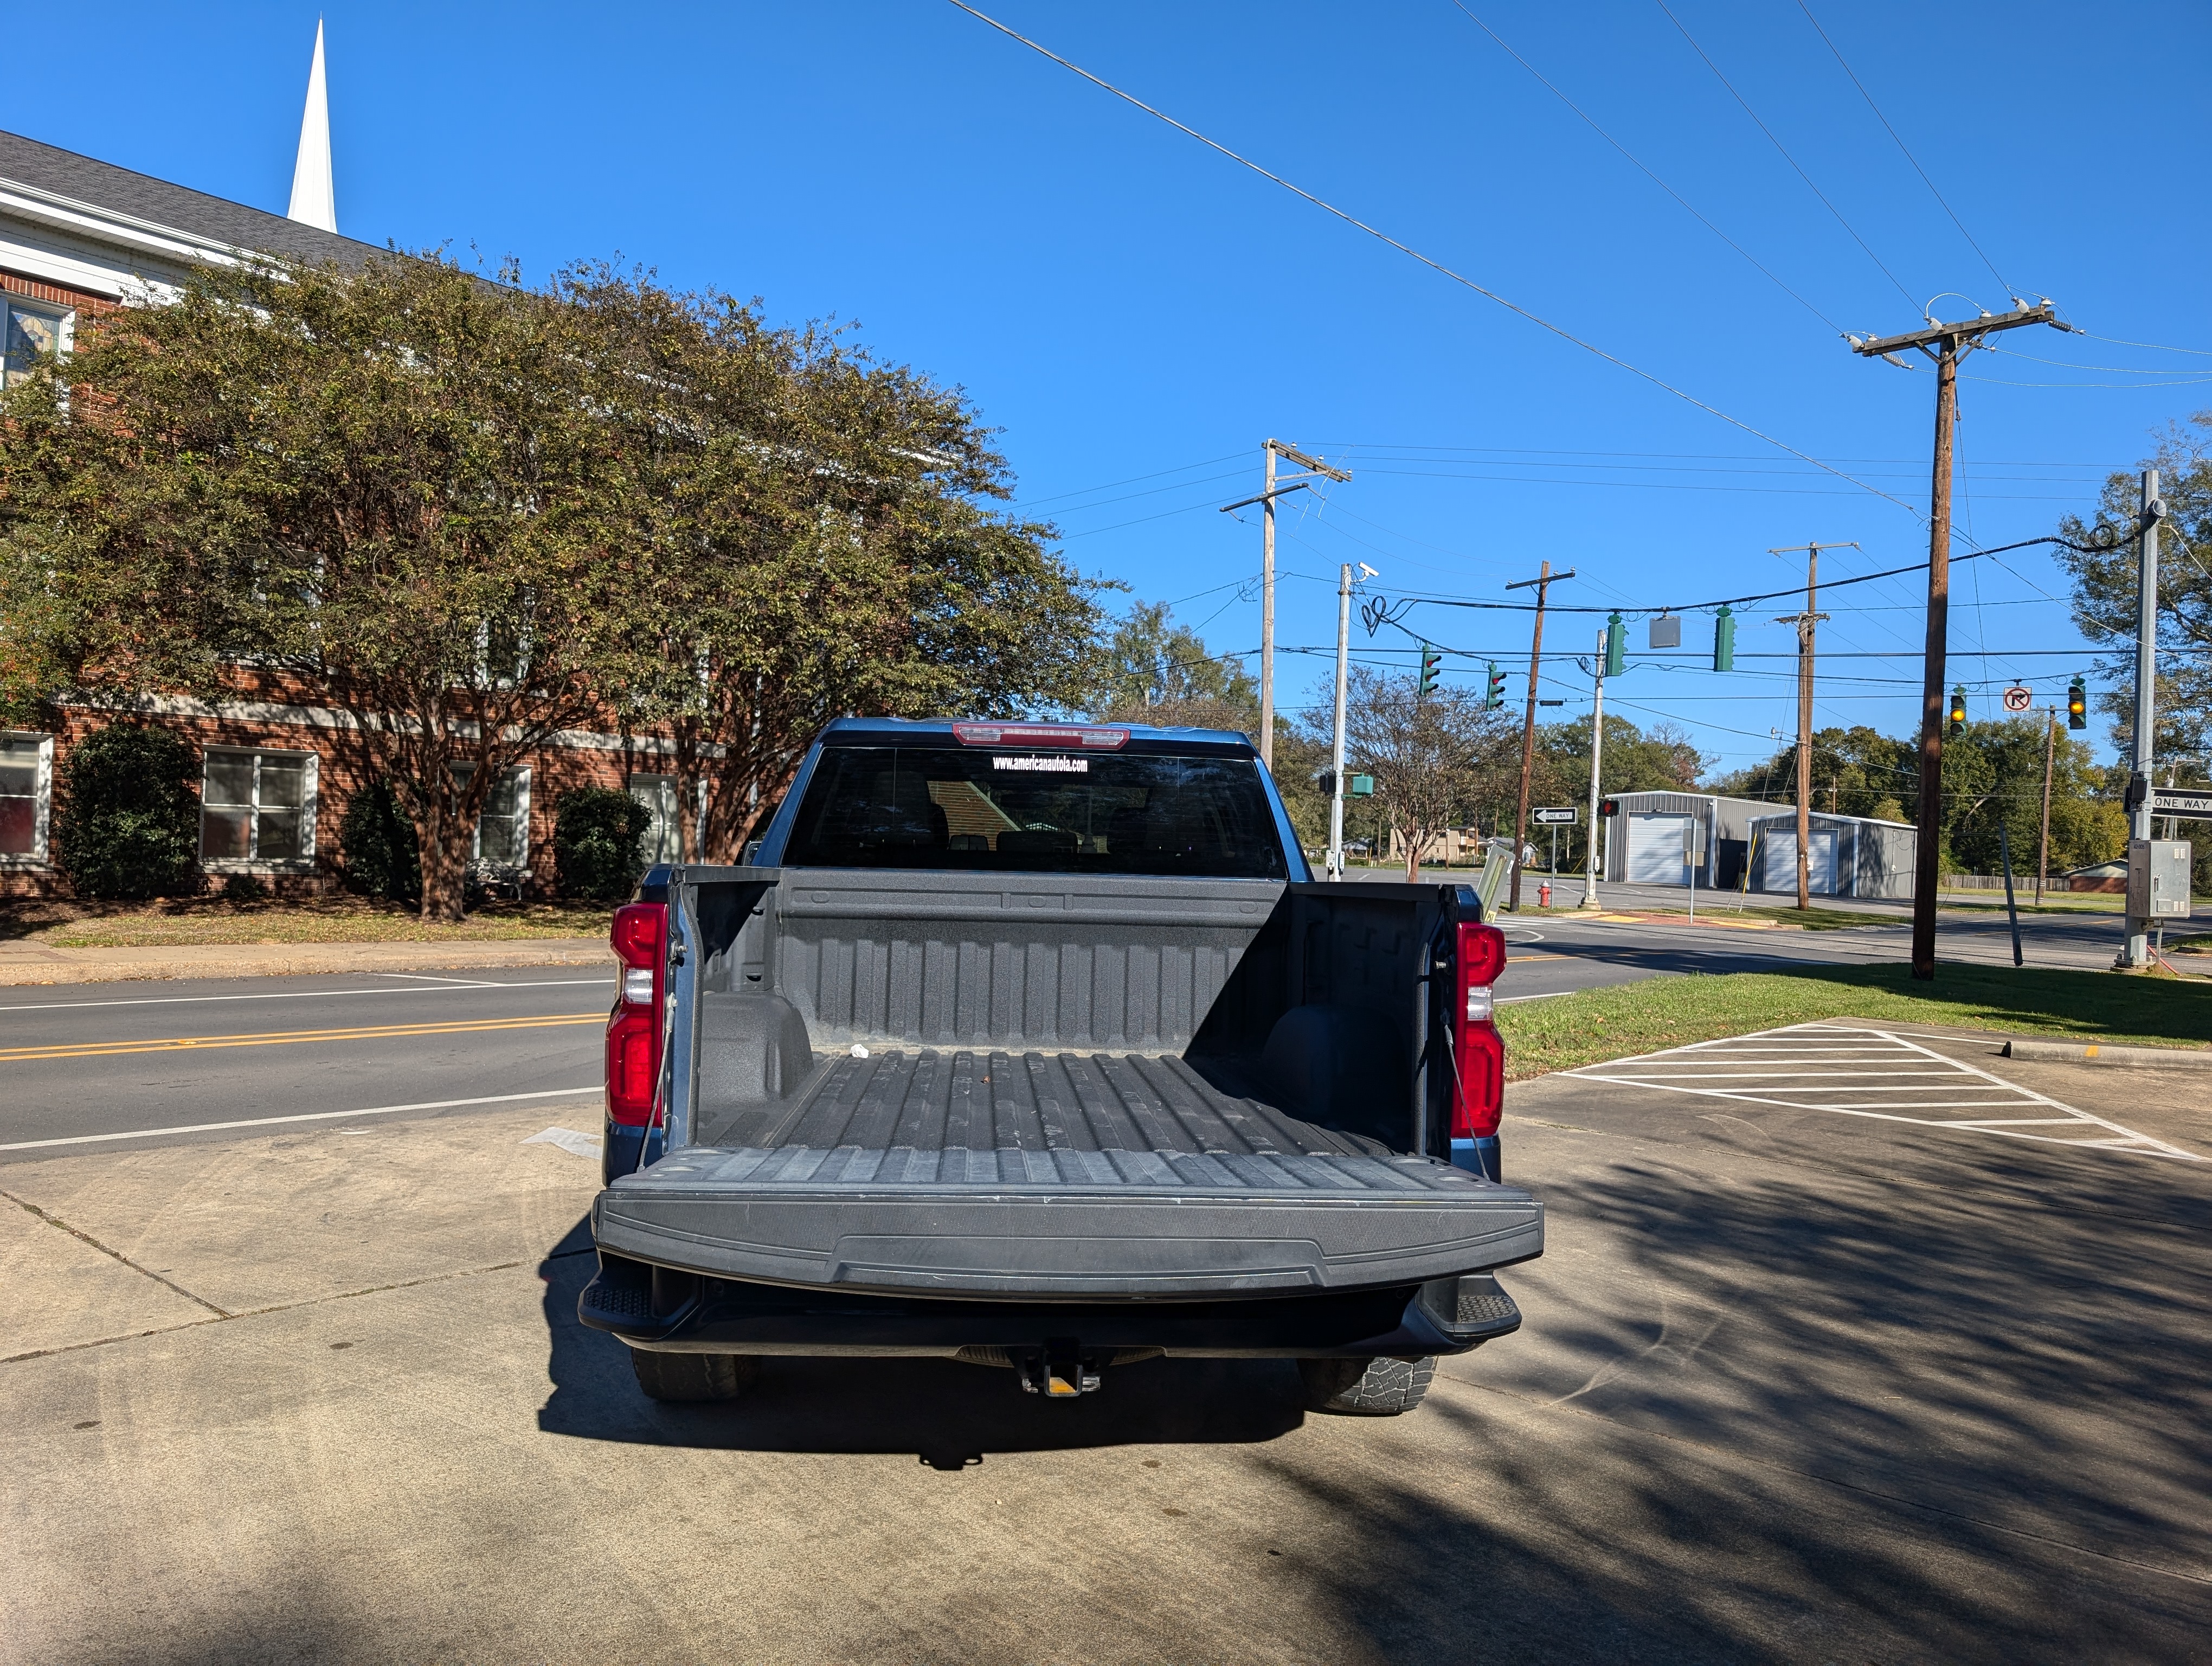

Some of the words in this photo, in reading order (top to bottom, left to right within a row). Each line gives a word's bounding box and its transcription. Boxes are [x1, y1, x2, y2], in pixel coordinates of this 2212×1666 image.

[993, 754, 1088, 772] www.americanautola.com
[2155, 797, 2178, 808] ONE
[2184, 799, 2209, 809] WAY
